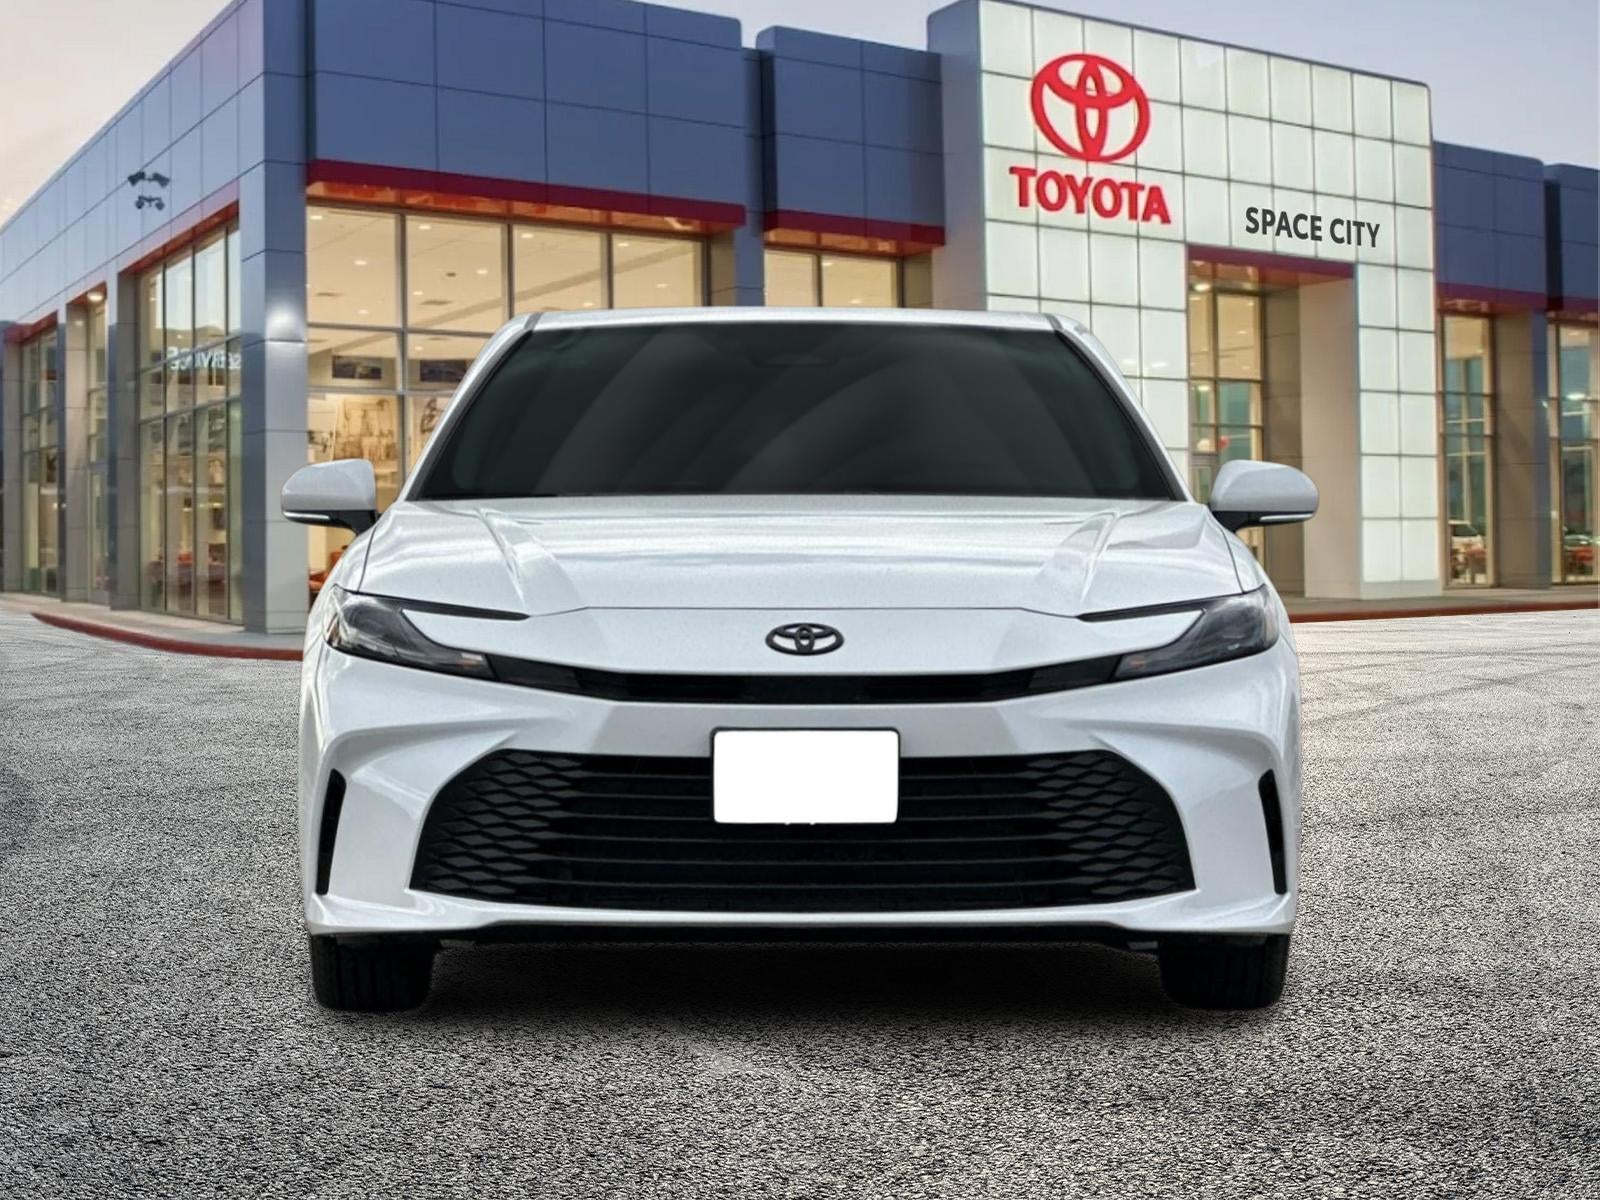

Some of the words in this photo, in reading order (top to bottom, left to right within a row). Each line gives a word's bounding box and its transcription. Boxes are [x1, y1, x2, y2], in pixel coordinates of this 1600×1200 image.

[1009, 167, 1171, 224] TOYOTA
[1245, 207, 1322, 242] SPACE
[1329, 218, 1380, 248] CITY
